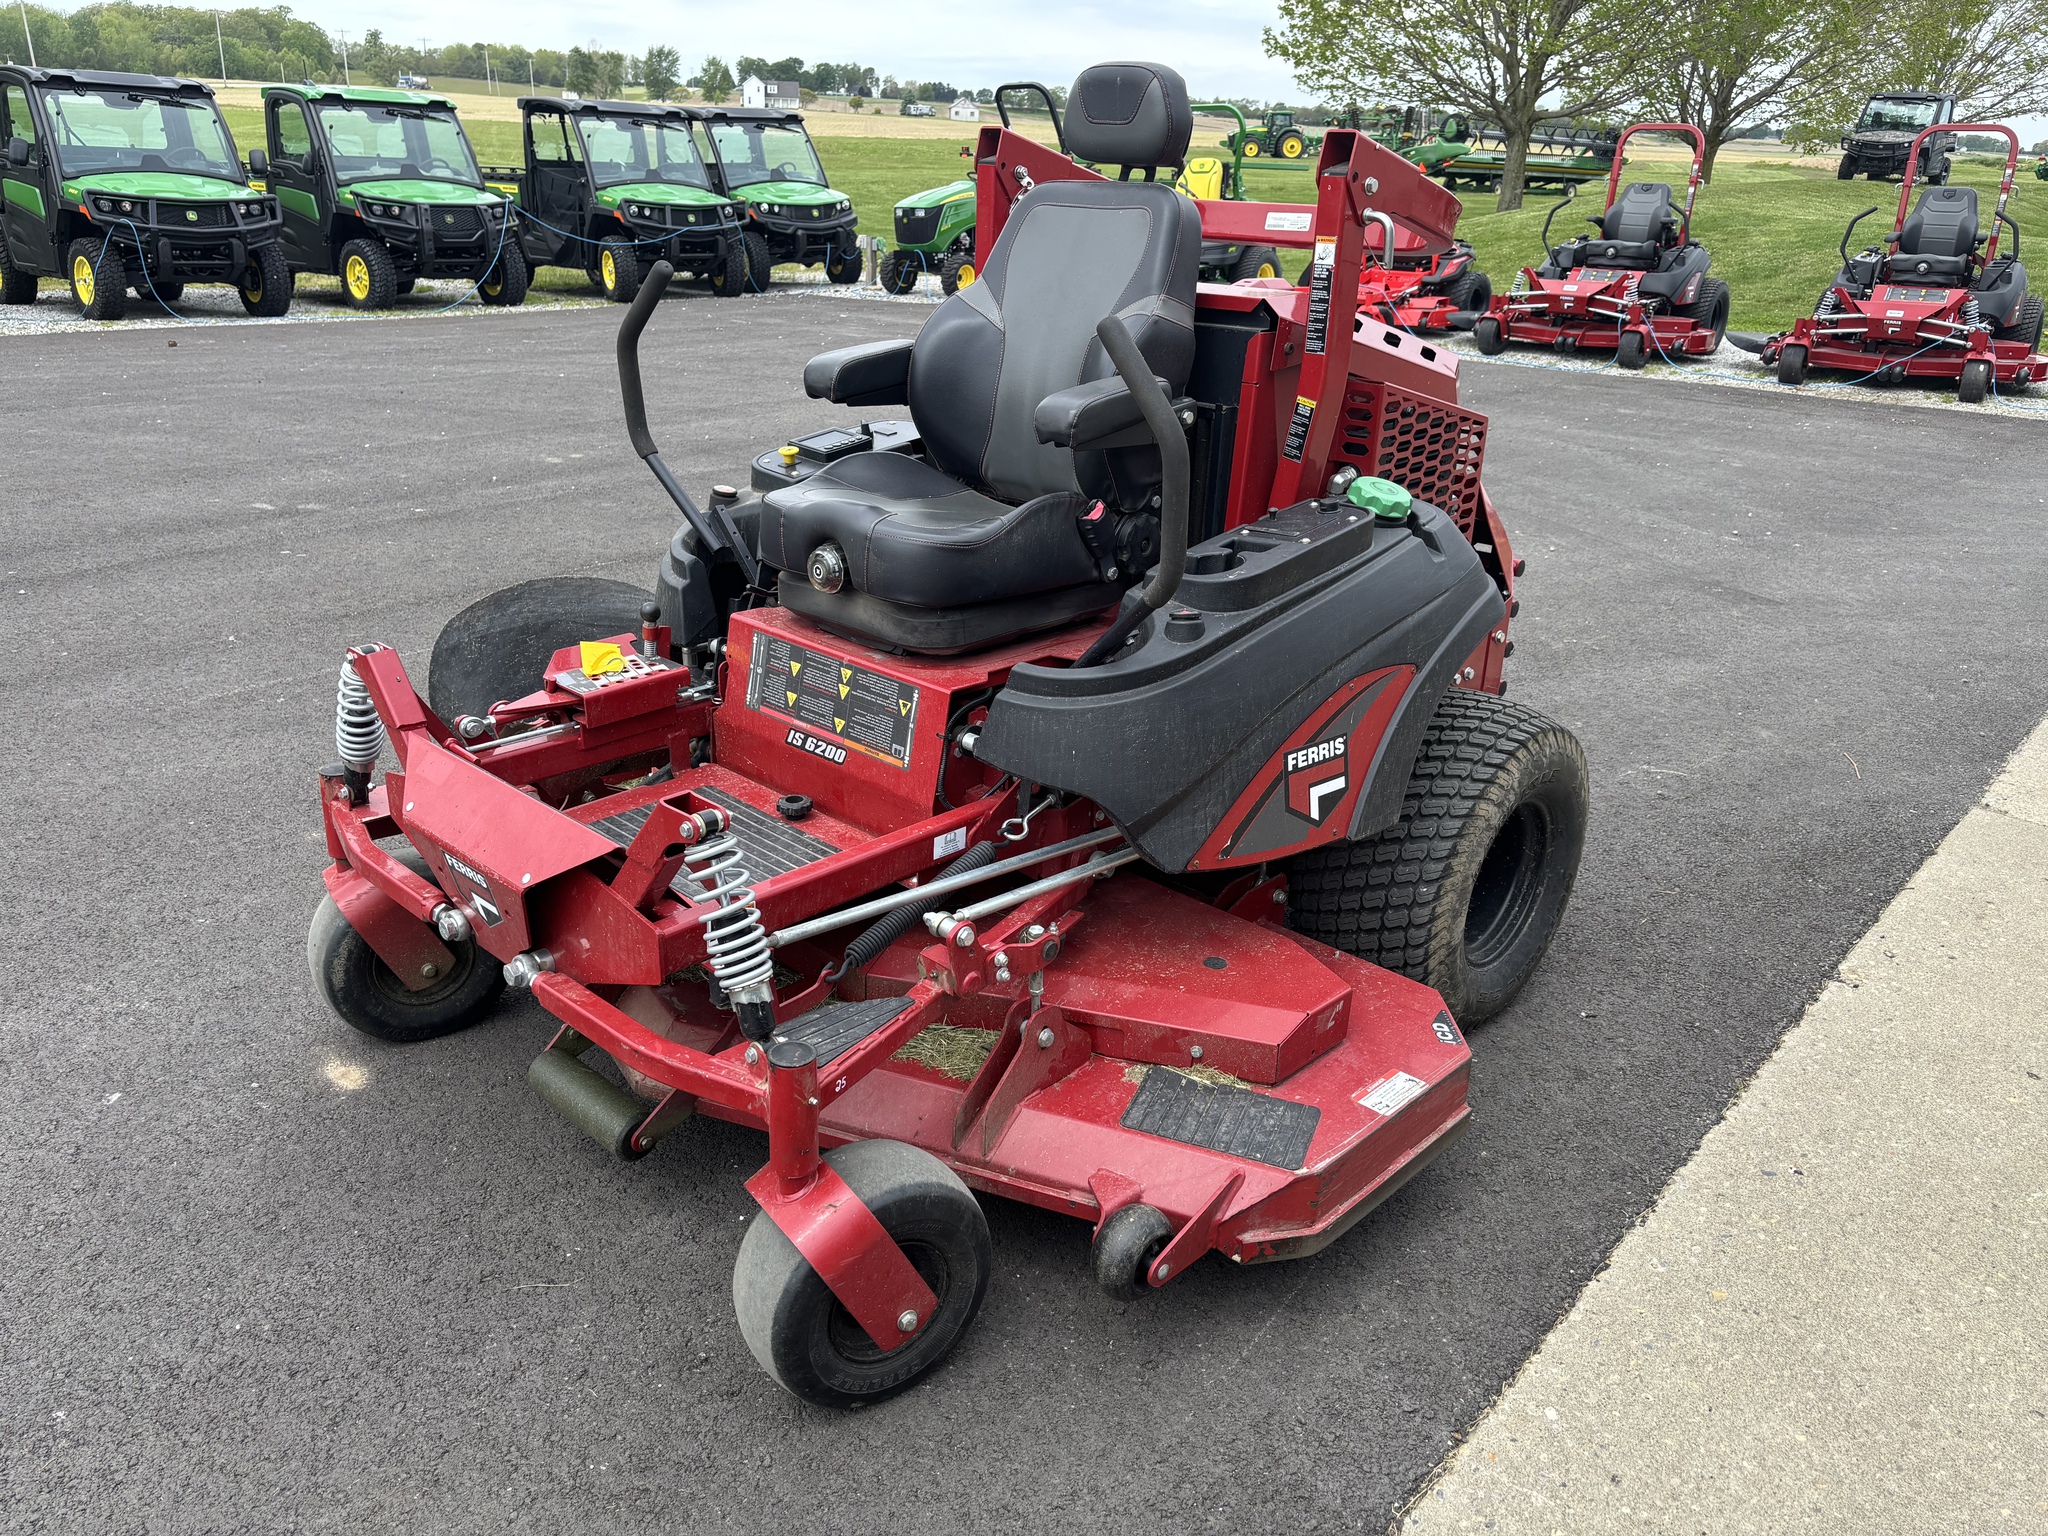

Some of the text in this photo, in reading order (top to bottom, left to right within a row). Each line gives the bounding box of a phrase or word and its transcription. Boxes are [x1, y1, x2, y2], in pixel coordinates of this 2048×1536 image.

[787, 729, 847, 764] IS 6200
[1287, 737, 1345, 772] FERRIS
[444, 852, 488, 889] FERRIS
